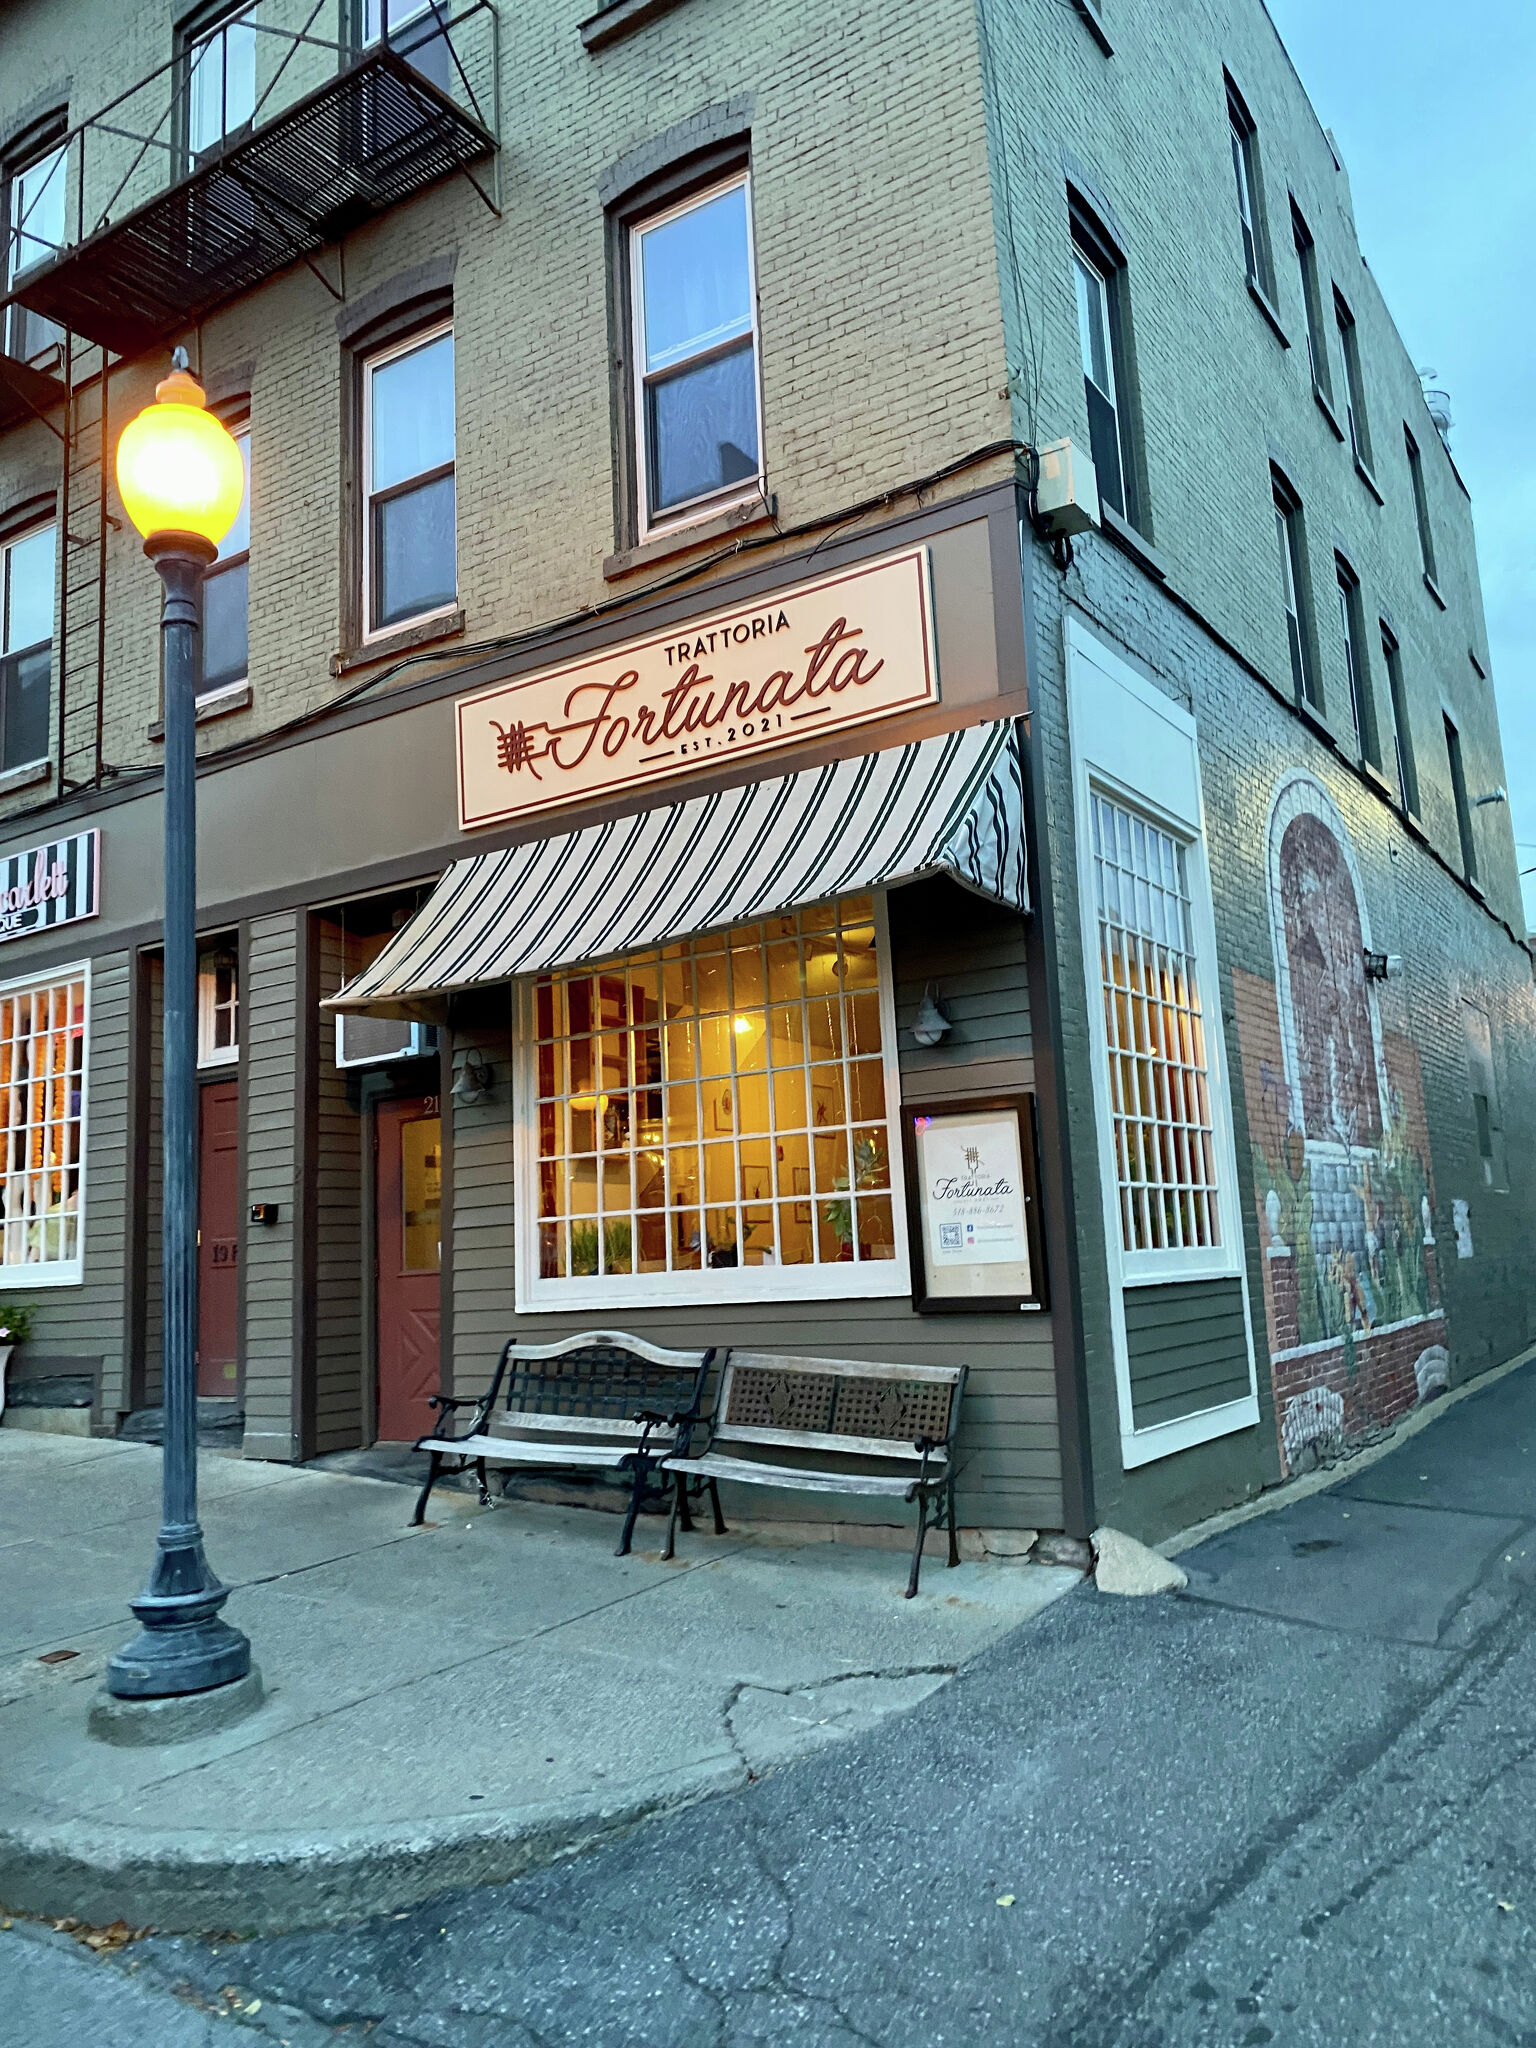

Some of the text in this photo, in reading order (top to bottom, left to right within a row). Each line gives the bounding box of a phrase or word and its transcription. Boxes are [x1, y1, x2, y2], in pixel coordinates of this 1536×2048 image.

[664, 610, 790, 666] TRATTORIA
[550, 616, 884, 768] Fortunata
[423, 1095, 440, 1114] 21
[932, 1178, 1014, 1200] Fortunata
